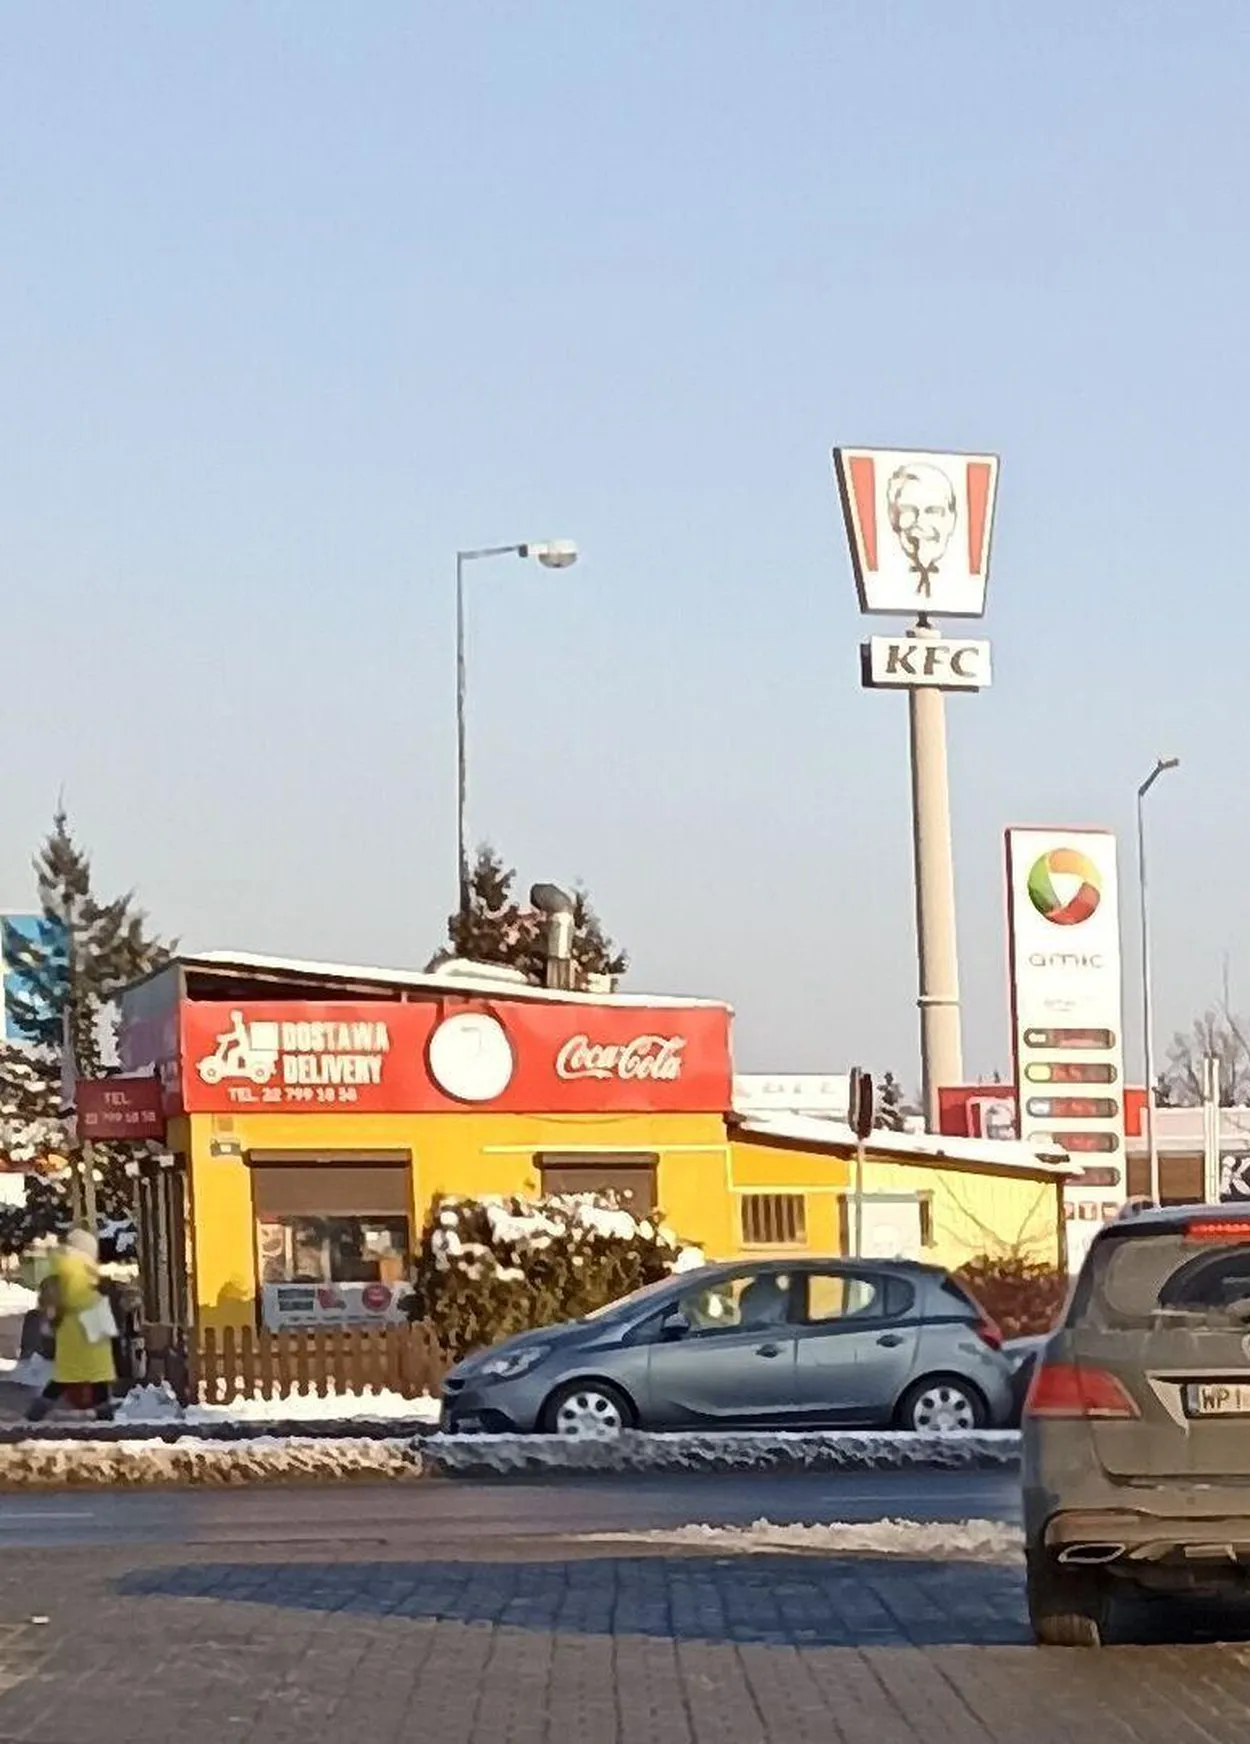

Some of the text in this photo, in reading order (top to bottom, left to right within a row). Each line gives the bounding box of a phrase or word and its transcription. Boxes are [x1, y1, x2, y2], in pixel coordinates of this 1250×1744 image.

[886, 644, 980, 678] KFC
[1028, 951, 1104, 969] amic
[281, 1021, 390, 1052] DOSTAWA
[282, 1054, 383, 1084] DELIVERY
